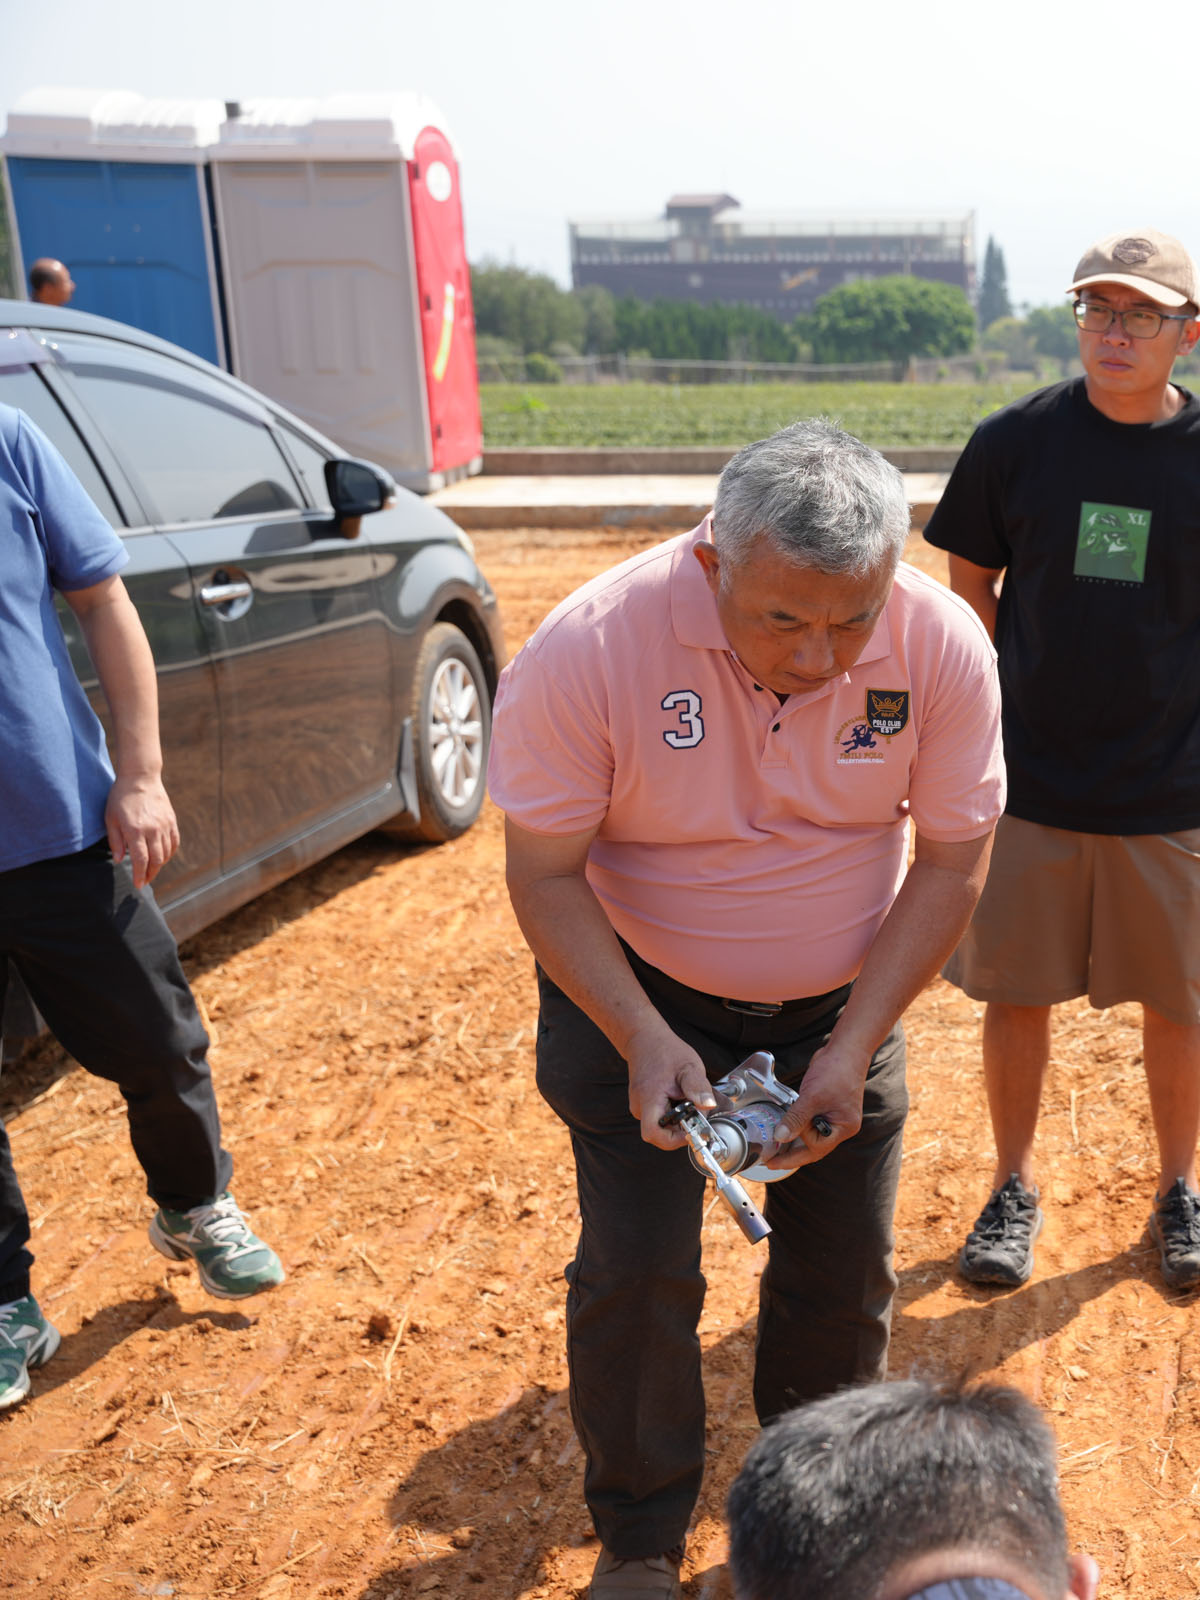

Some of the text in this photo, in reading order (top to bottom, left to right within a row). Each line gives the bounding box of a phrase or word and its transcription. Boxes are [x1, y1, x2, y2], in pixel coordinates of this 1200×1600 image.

[1128, 512, 1146, 526] XL
[661, 690, 705, 750] 3
[887, 720, 902, 728] CLUB
